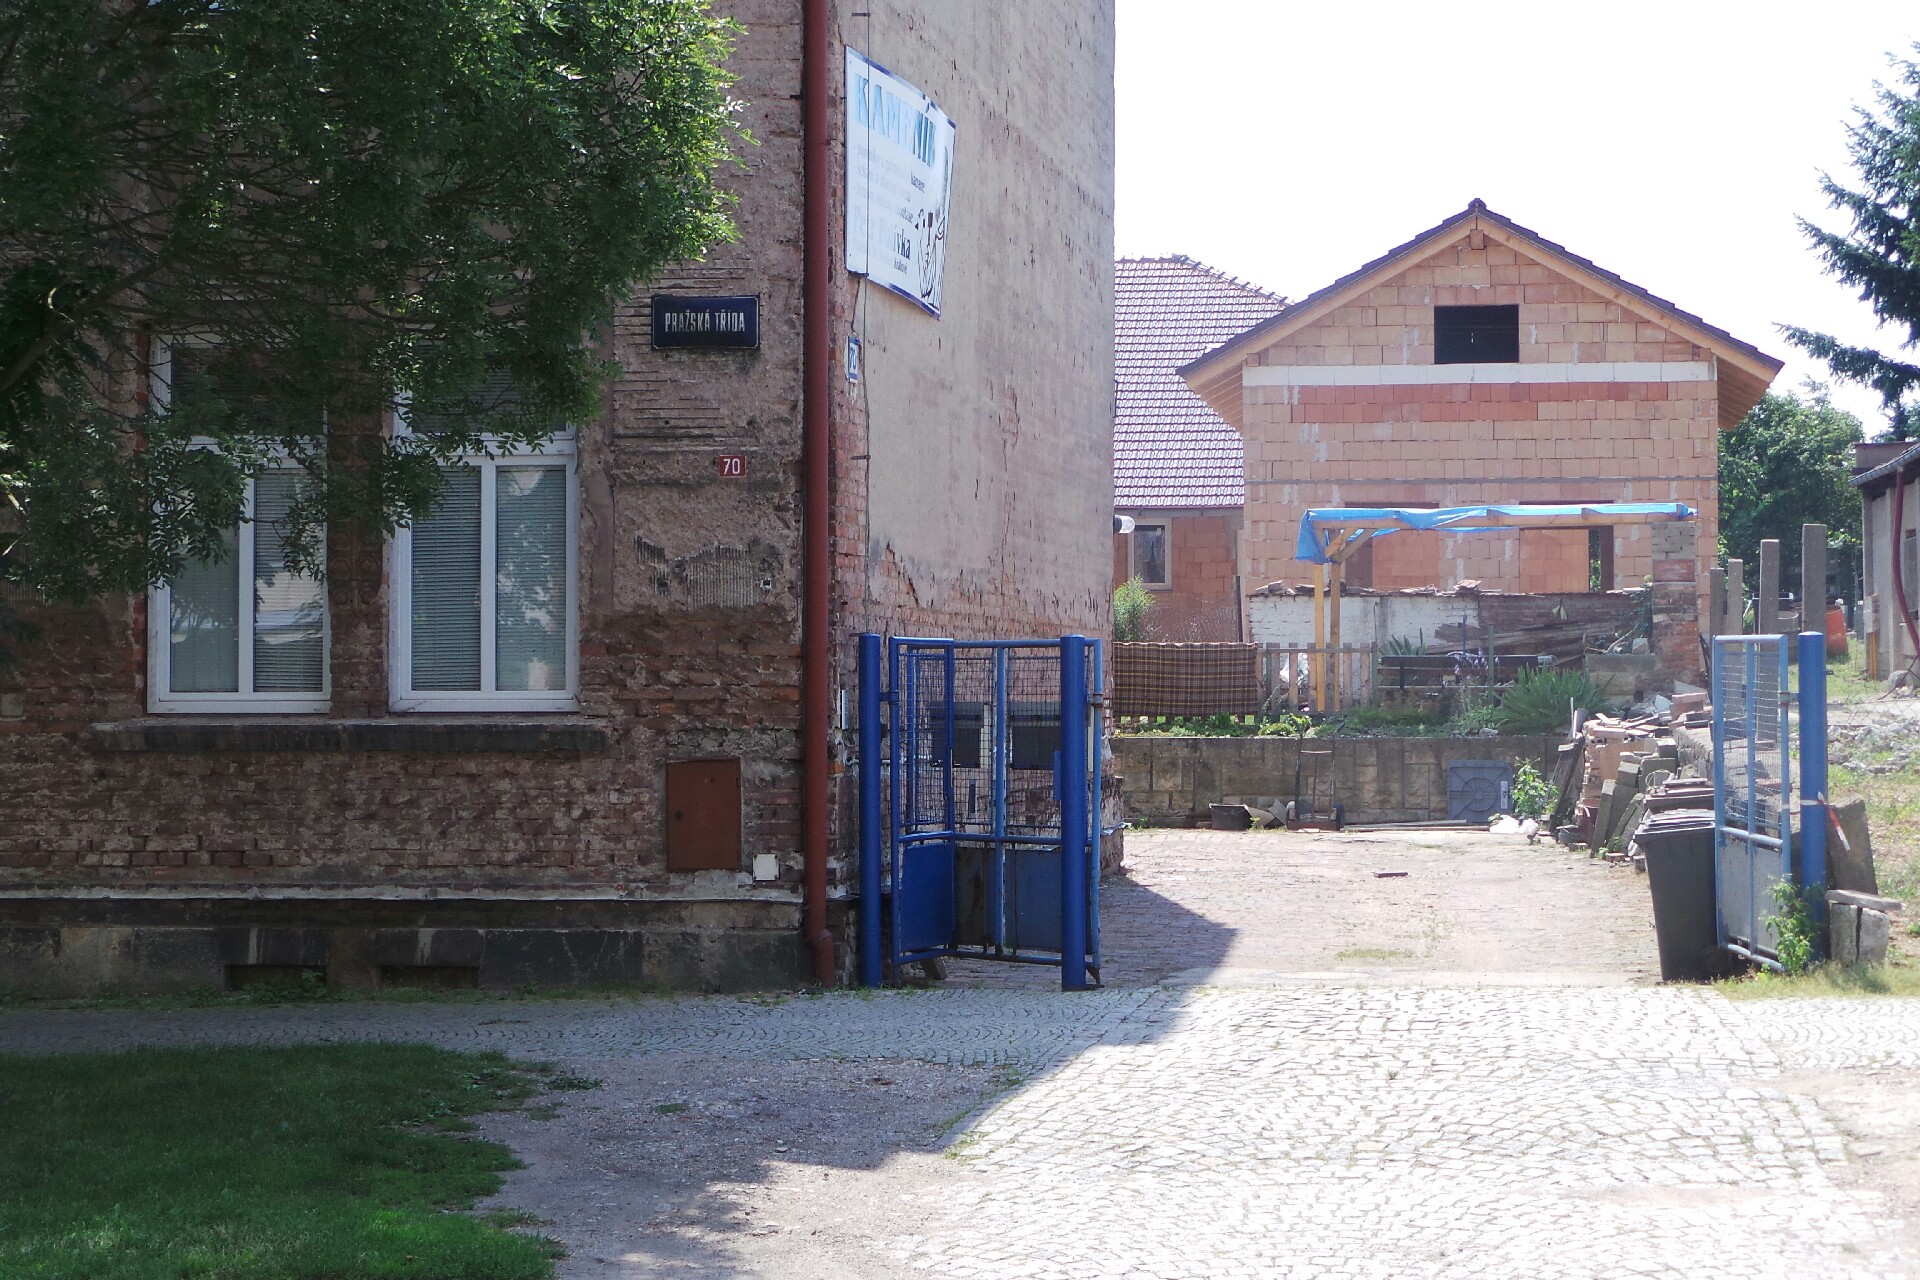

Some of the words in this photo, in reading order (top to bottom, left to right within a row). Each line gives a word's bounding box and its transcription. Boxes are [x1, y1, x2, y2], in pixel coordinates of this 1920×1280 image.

[665, 309, 711, 332] PRAŽSKÁ
[714, 309, 745, 332] TŘÍDA
[723, 458, 741, 475] 70
